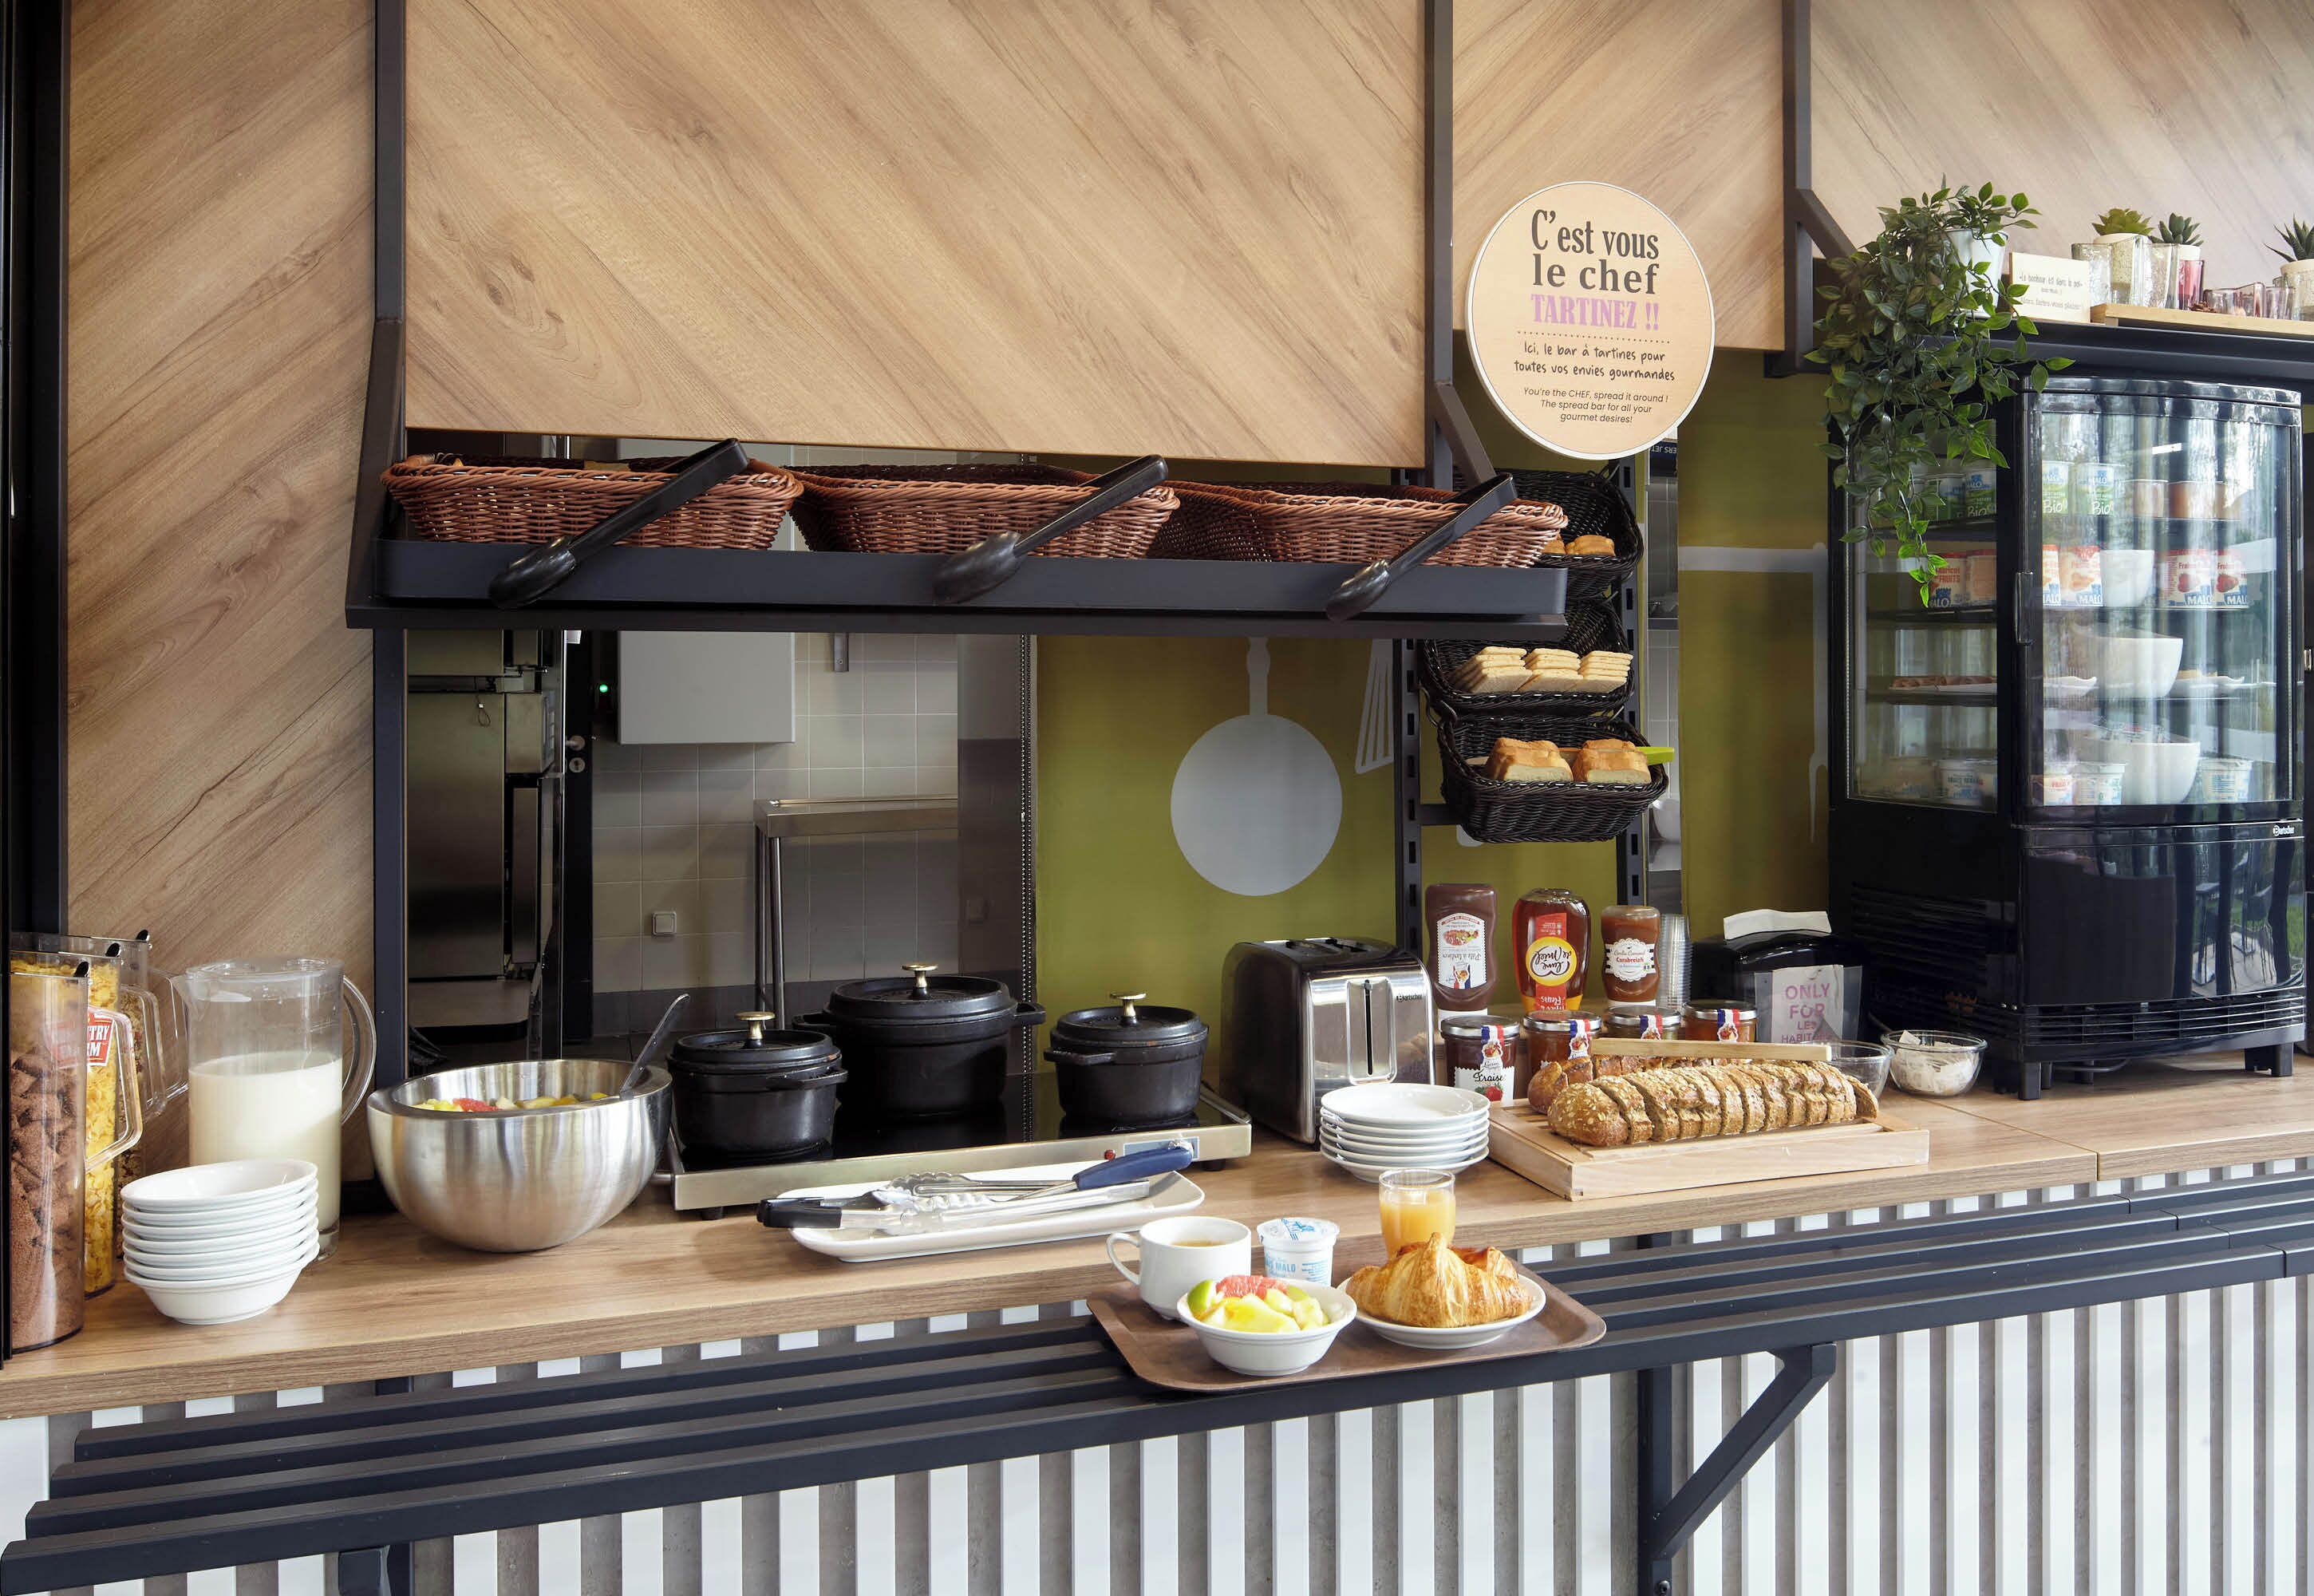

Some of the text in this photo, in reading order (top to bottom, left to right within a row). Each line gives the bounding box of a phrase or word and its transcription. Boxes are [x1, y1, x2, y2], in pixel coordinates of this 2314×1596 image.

[1531, 209, 1660, 259] C'est vous
[1533, 254, 1660, 294] le chef
[1530, 294, 1637, 330] TARTINEZ
[1524, 341, 1665, 365] Ici, le bar à tartines pour
[1514, 360, 1676, 381] toutes vos envies gourmandes
[1523, 387, 1551, 397] You're
[1552, 389, 1567, 397] the
[1568, 389, 1592, 400] CHEF,
[1593, 392, 1624, 401] spread
[1625, 392, 1632, 401] it
[1633, 394, 1664, 403] around
[1541, 399, 1653, 415] The spread bar for all your
[1560, 413, 1633, 424] gourmet desires!
[2043, 499, 2063, 514] Bio
[2092, 500, 2111, 516] Bio
[1785, 982, 1830, 1000] ONLY
[1789, 1003, 1826, 1019] FOR
[1797, 1021, 1817, 1030] LES
[1473, 1069, 1504, 1082] Fraise
